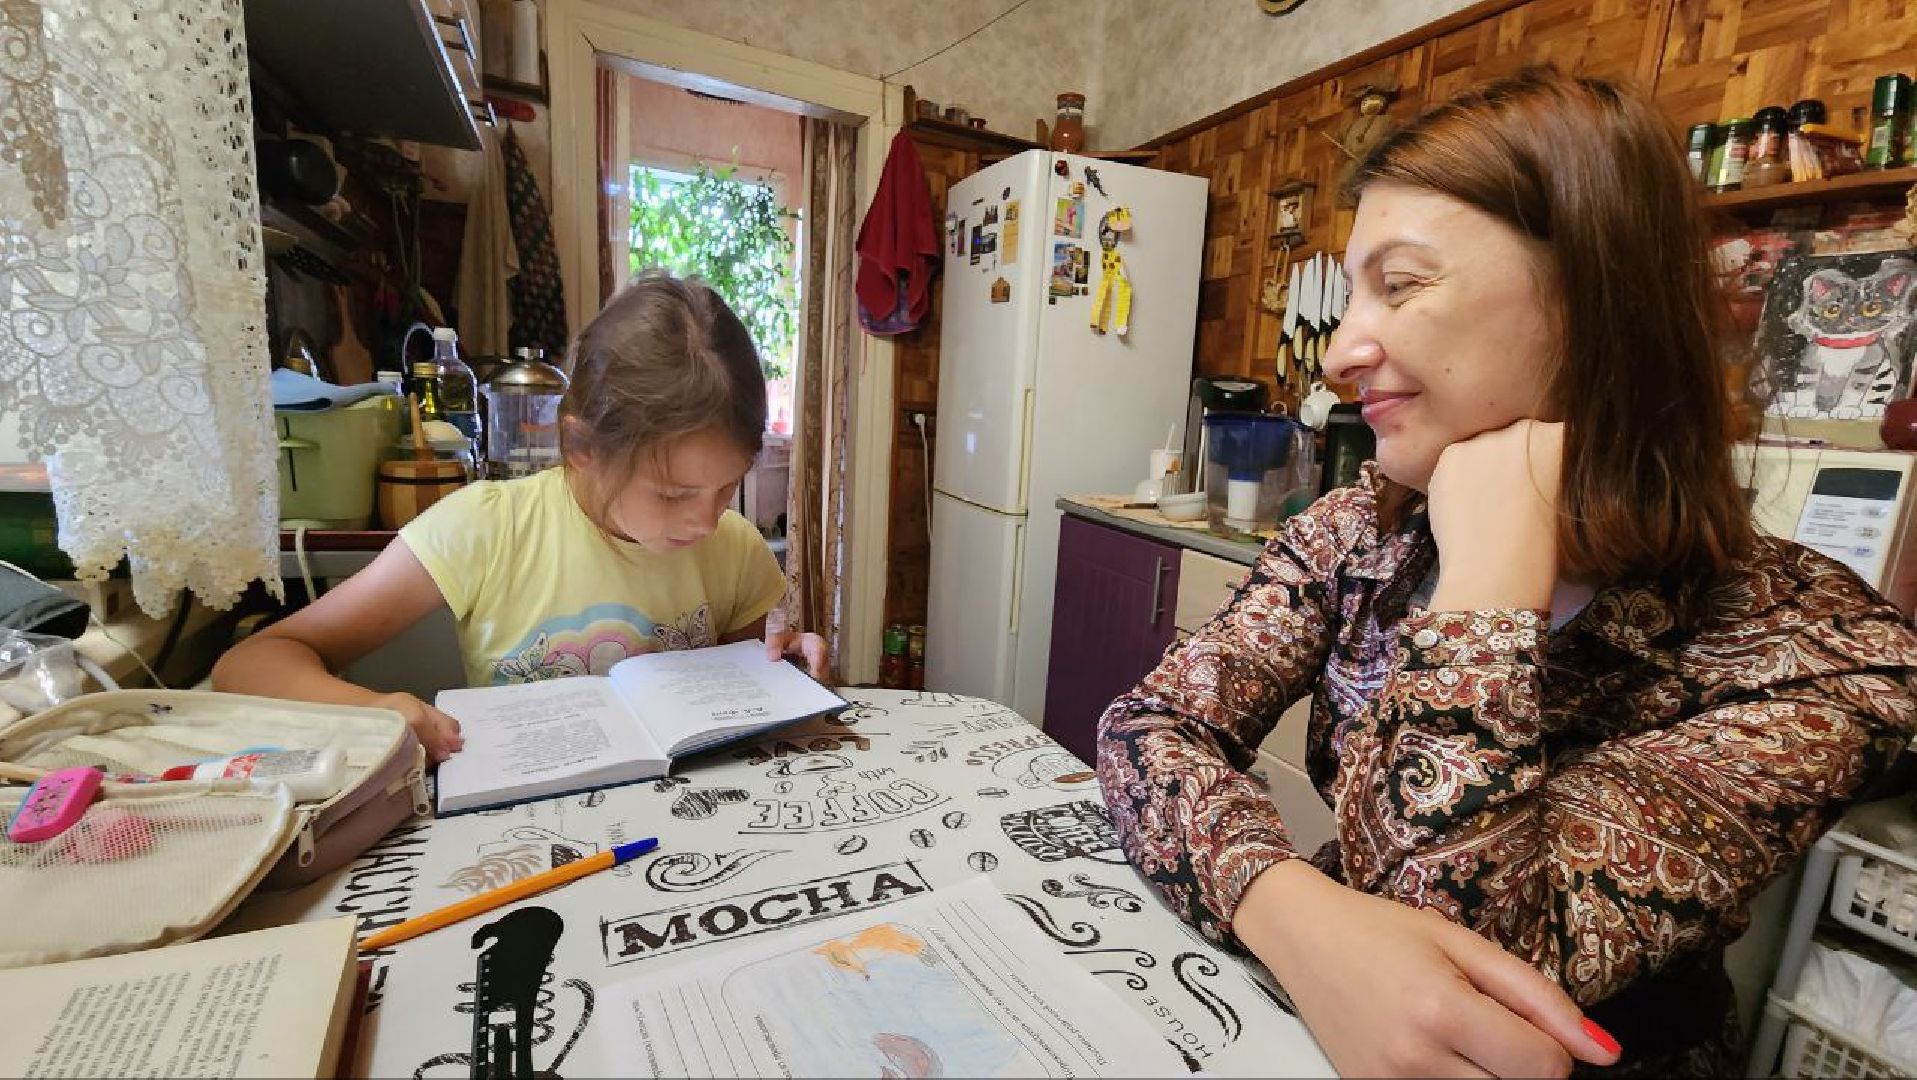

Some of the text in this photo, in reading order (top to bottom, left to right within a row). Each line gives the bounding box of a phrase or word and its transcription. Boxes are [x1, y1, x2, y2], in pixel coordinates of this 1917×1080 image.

[747, 777, 940, 830] COFFEE
[857, 767, 896, 782] with
[614, 873, 924, 957] MOCHA
[1142, 995, 1214, 1059] HOUSE
